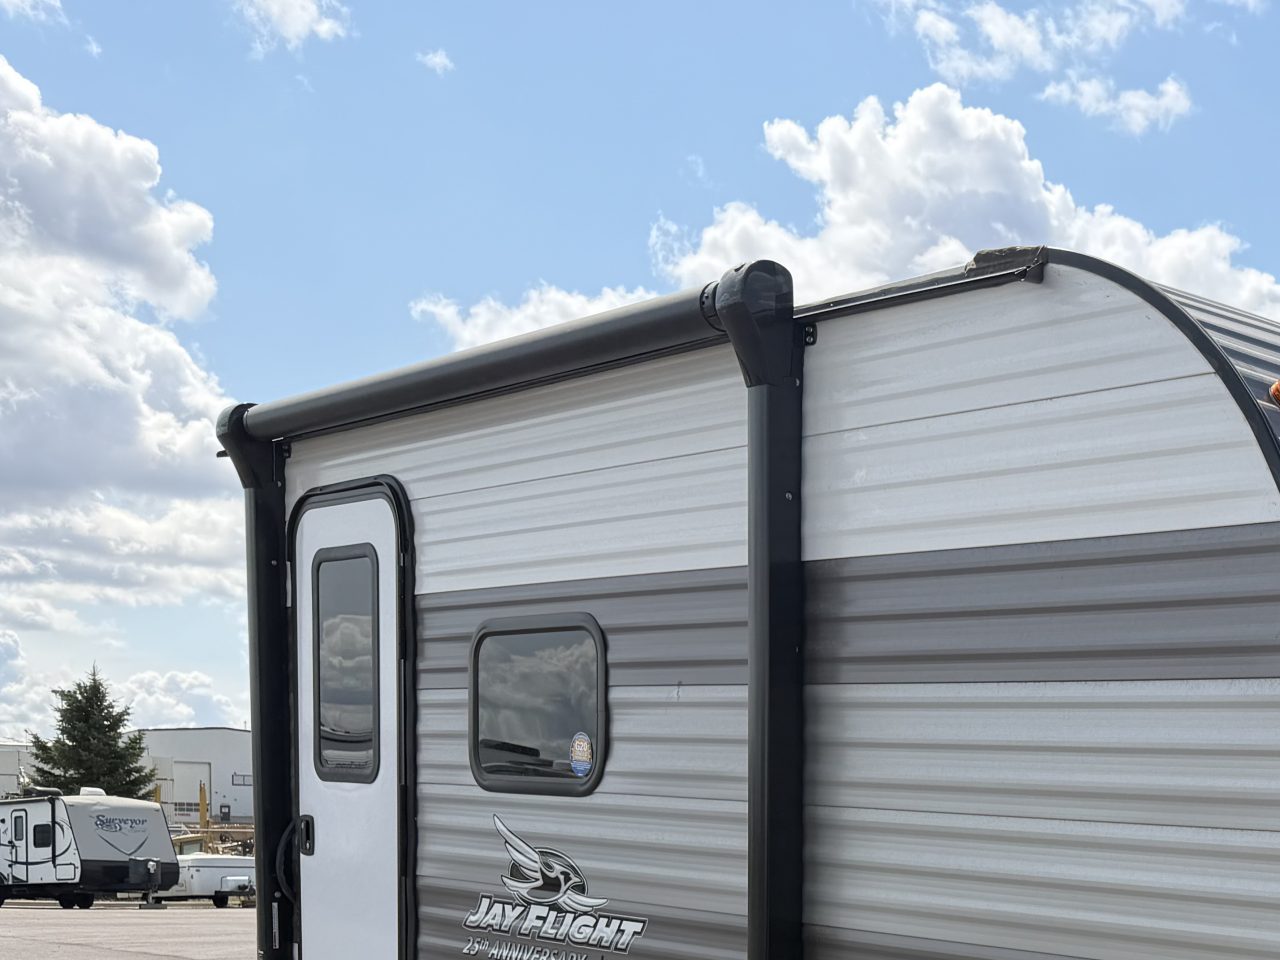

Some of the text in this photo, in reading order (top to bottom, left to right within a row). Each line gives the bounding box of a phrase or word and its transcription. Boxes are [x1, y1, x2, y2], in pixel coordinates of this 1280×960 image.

[95, 814, 148, 829] Surveyor
[463, 893, 648, 954] JAY FLIGHT
[462, 936, 489, 956] 25th
